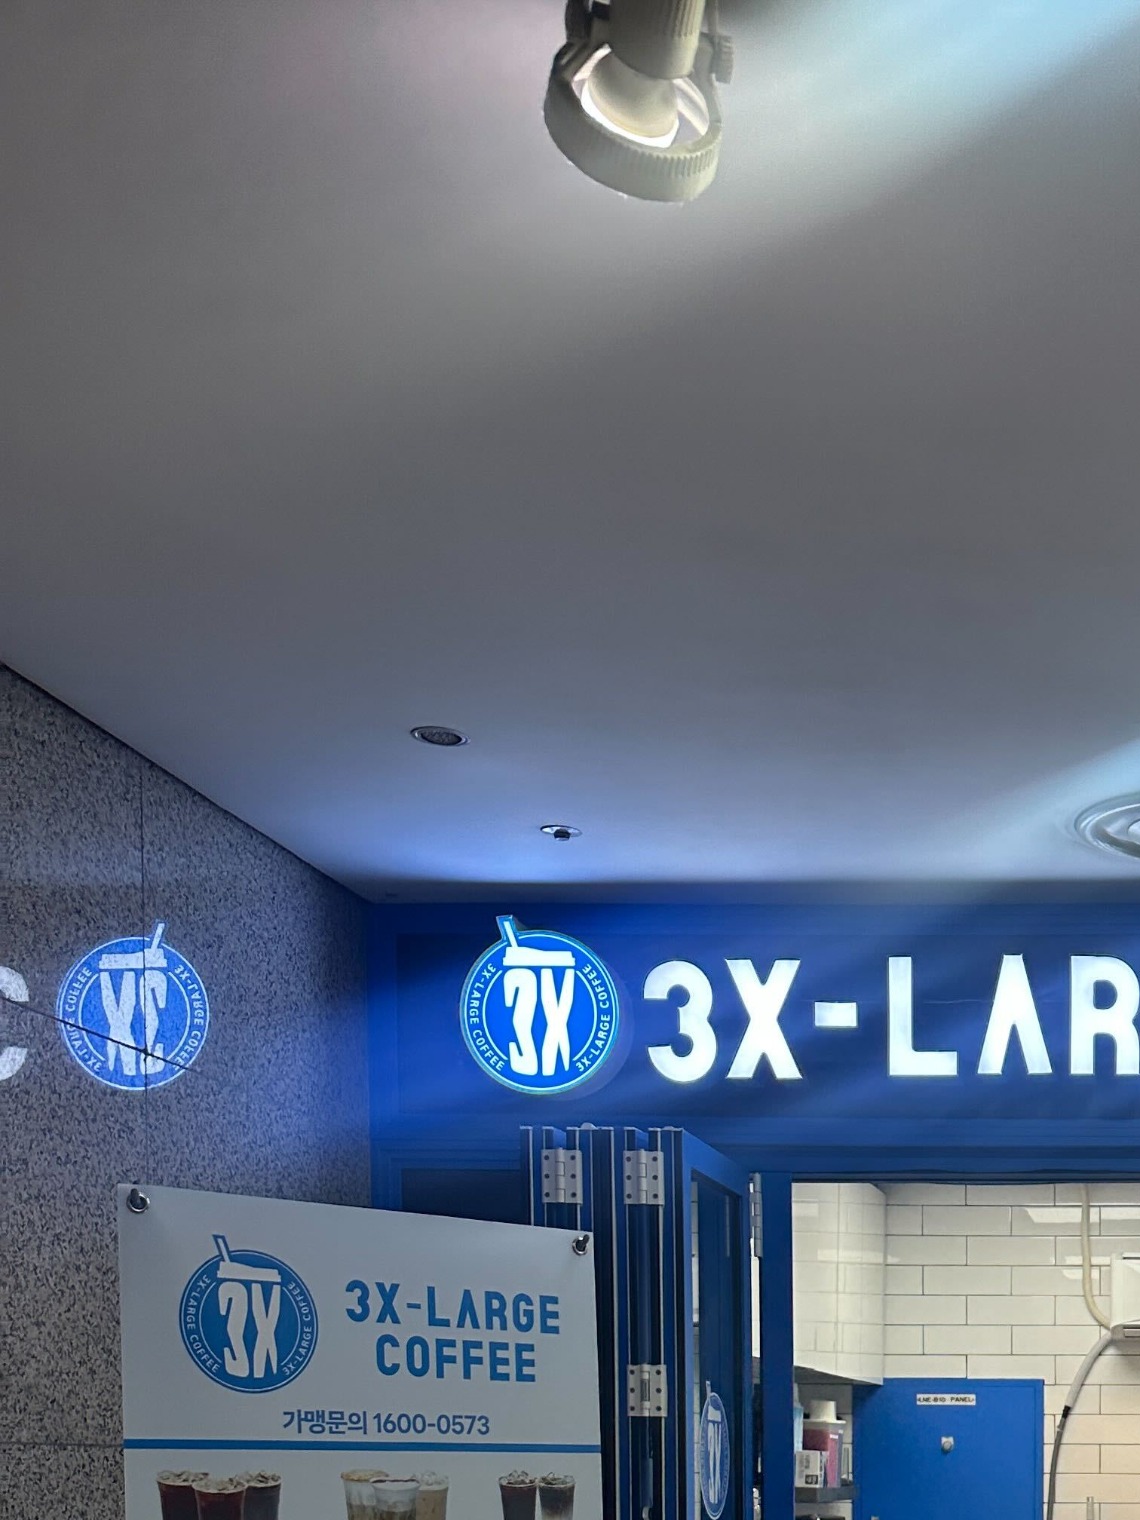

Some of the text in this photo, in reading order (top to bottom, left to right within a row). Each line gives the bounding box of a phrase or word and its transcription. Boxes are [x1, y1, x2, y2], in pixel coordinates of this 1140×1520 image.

[469, 963, 505, 1072] 3X-LARGE COFFEE
[503, 967, 575, 1076] 3X
[575, 963, 611, 1072] 3X-LARGE COFFEE
[186, 1274, 221, 1373] 3X-LARGE COFFEE
[218, 1281, 281, 1379] 3X
[282, 1282, 312, 1376] 3X-LARGE COFFEE
[344, 1278, 561, 1336] 3X-LARGE
[375, 1335, 537, 1384] COFFEE
[282, 1409, 490, 1436] 가맹문의 1600-0573
